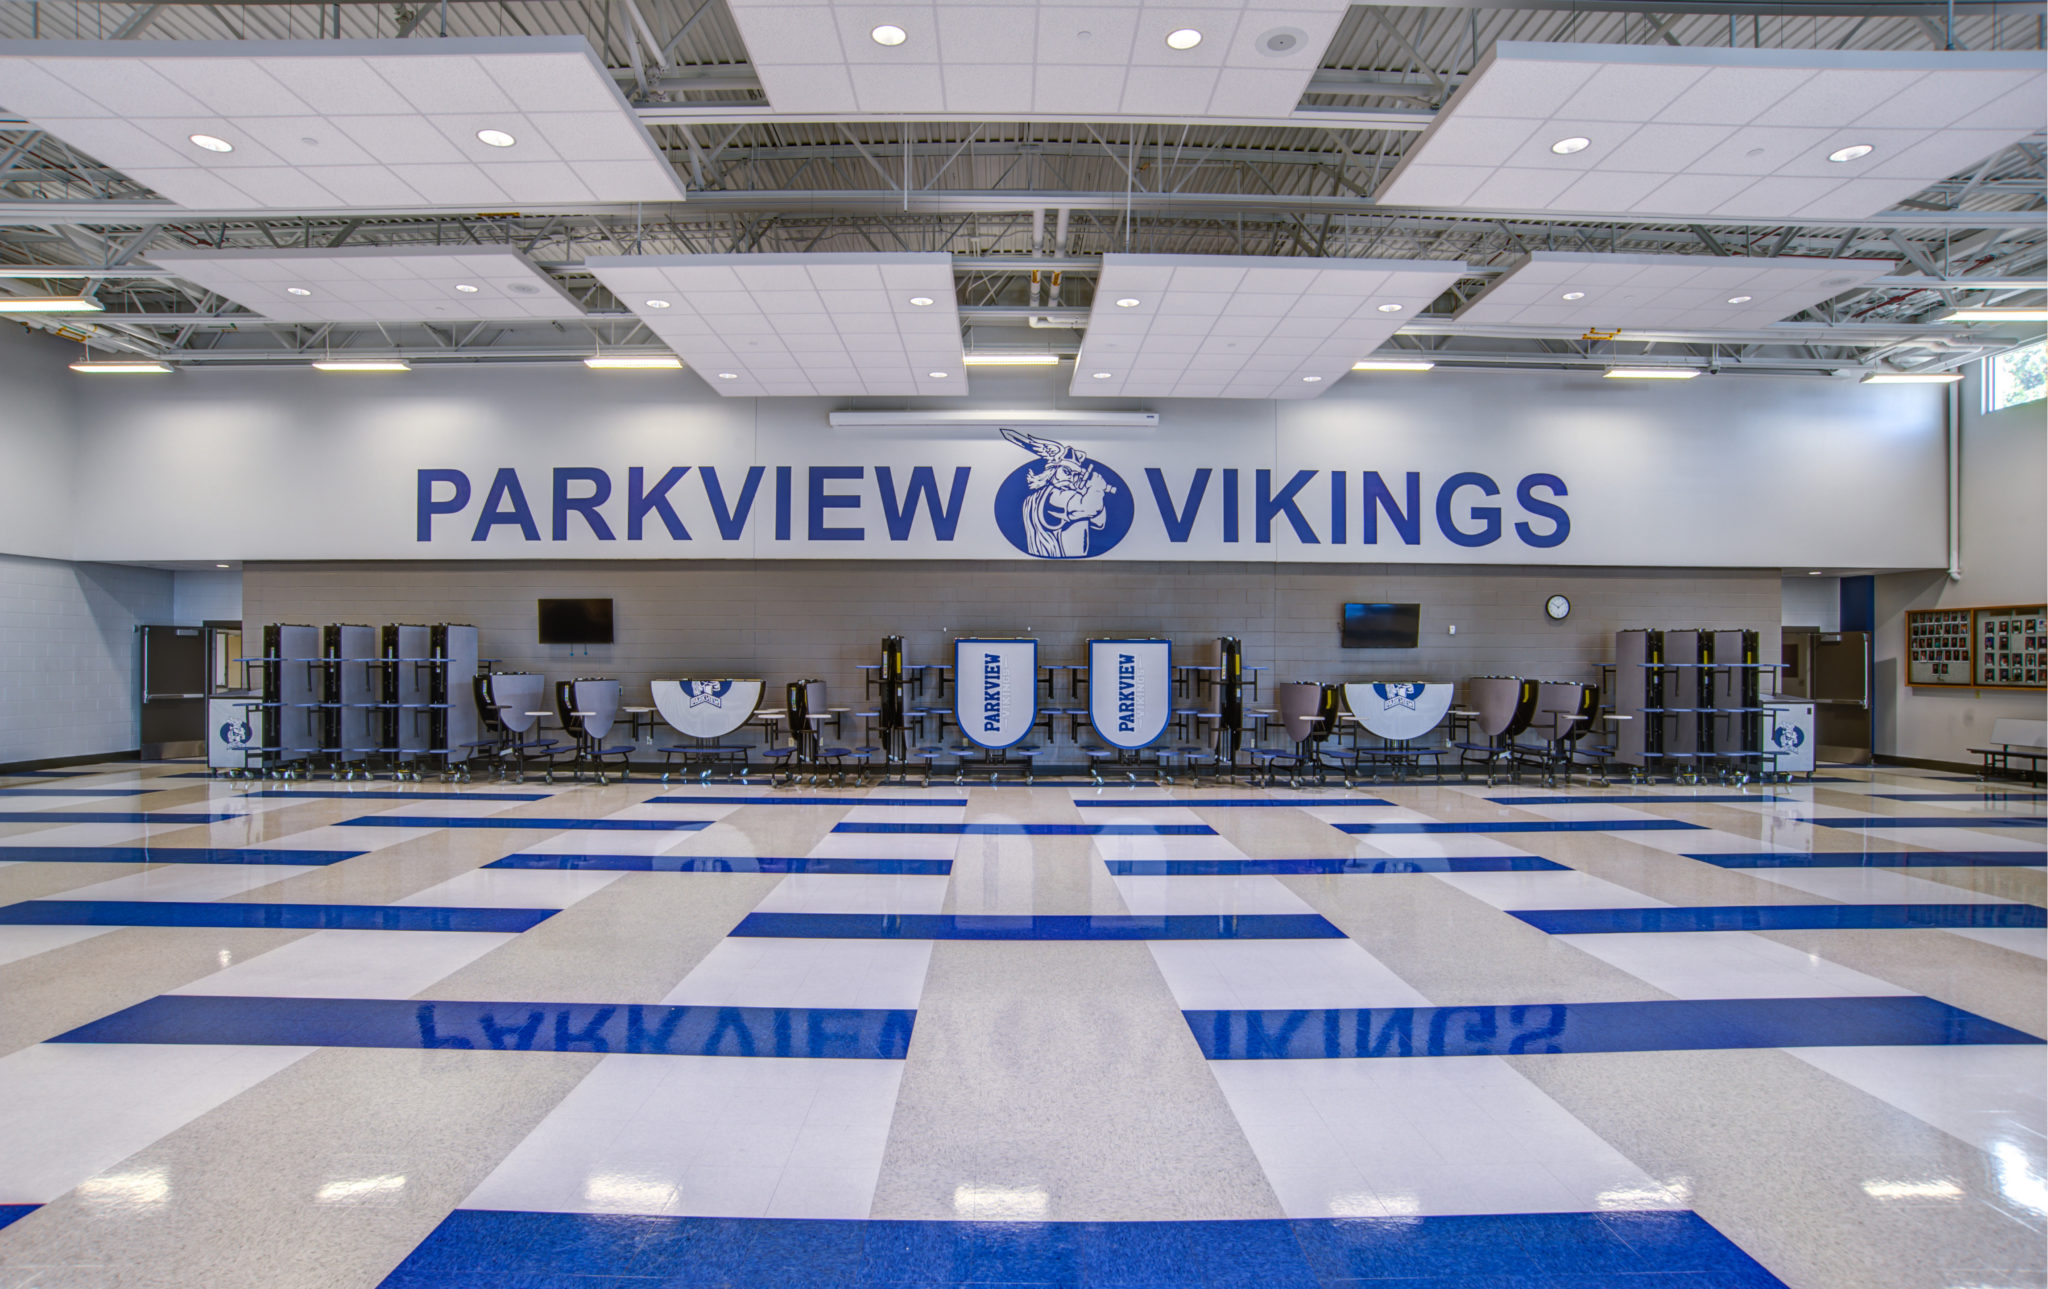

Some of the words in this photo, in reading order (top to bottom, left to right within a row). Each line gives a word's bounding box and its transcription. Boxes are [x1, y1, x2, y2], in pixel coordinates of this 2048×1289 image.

[416, 466, 972, 542] PARKVIEW
[1144, 467, 1572, 548] VIKINGS
[984, 653, 1000, 732] PARKVIEW
[1119, 653, 1135, 732] PARKVIEW
